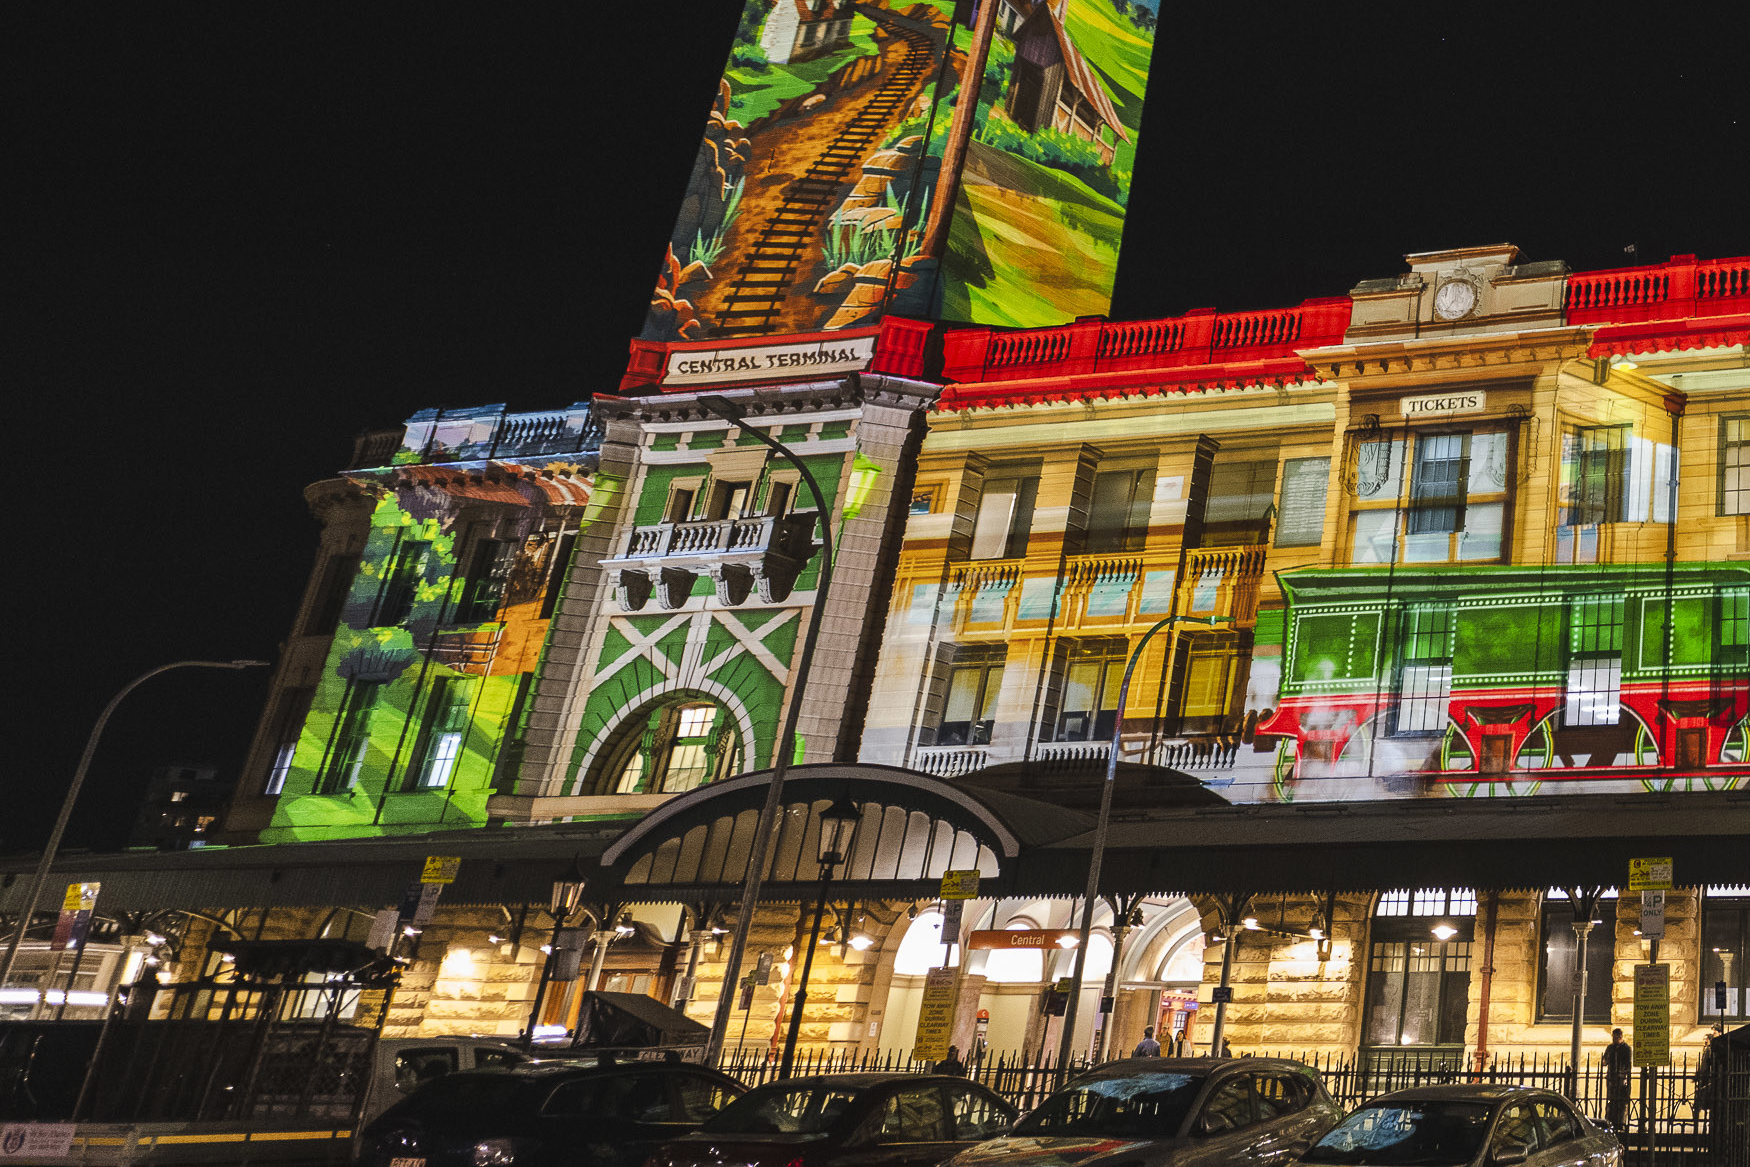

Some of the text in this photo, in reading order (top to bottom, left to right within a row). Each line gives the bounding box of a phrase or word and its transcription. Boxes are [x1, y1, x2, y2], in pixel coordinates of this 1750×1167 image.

[677, 347, 861, 375] CENTRAL TERMINAL
[1408, 395, 1477, 413] TICKETS
[1643, 909, 1662, 917] ONLY
[1010, 934, 1045, 946] Central
